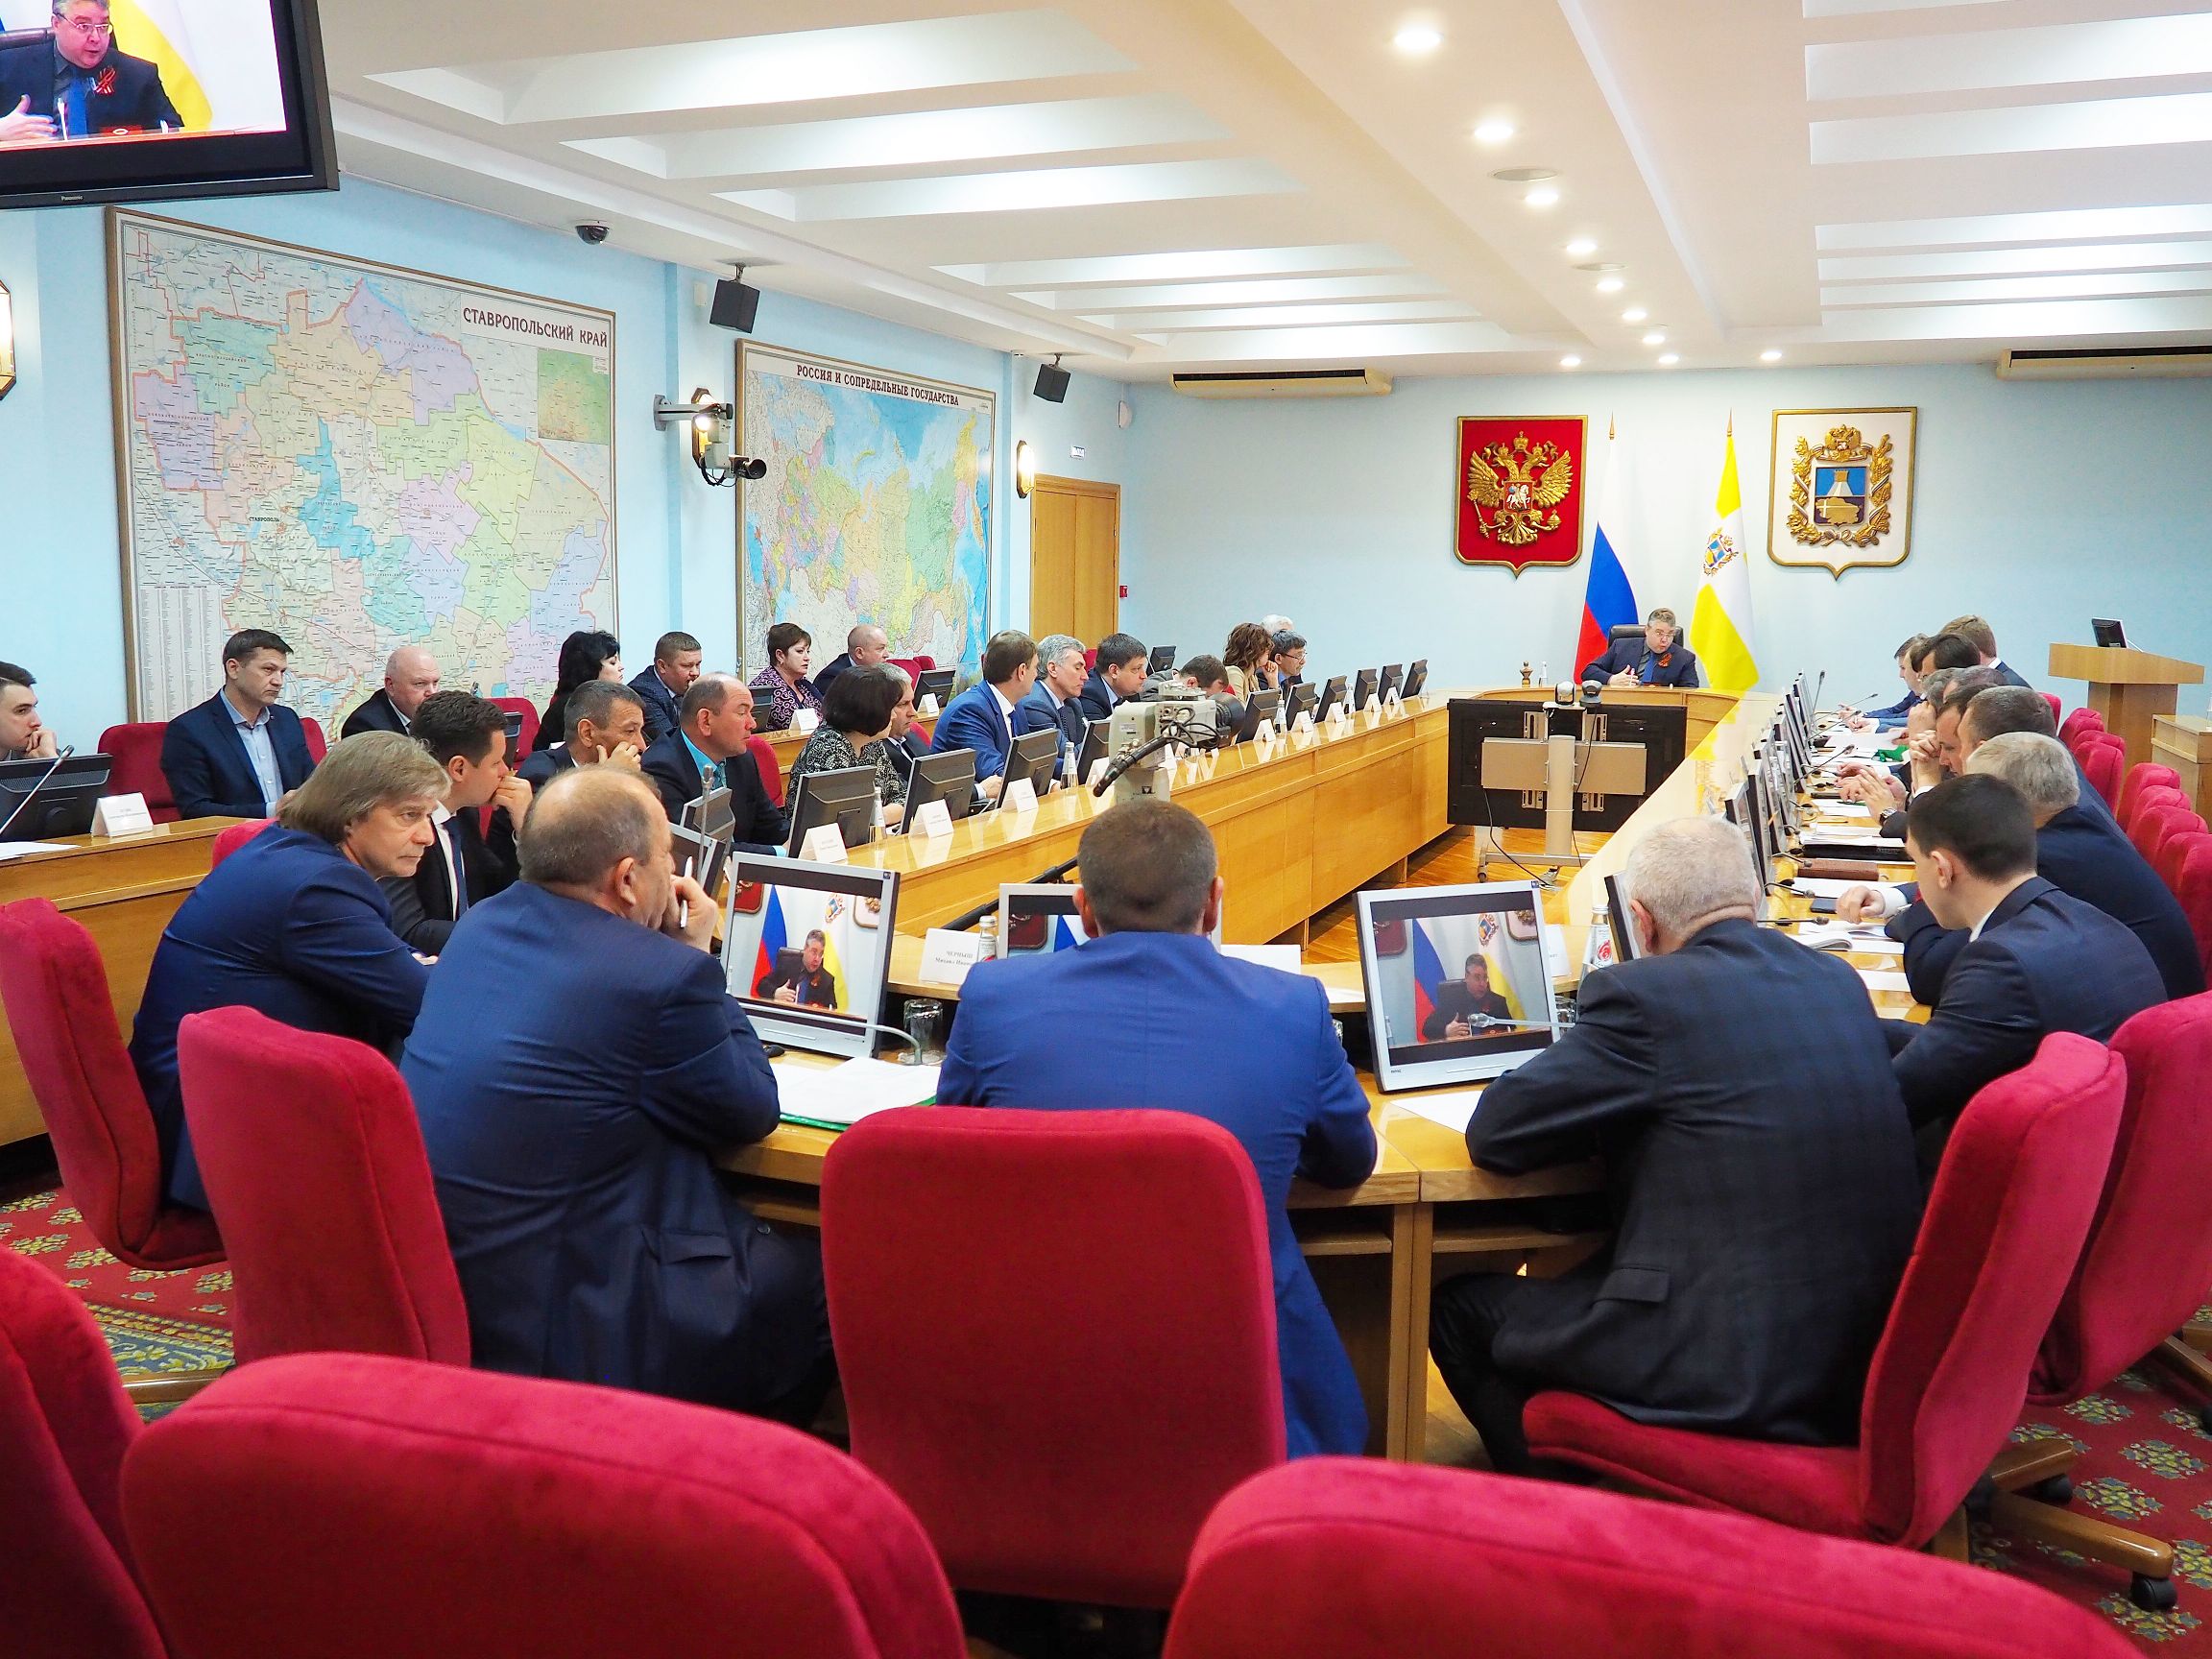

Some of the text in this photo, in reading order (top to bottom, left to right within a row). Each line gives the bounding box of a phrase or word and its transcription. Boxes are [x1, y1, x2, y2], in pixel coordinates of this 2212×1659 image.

[463, 307, 608, 348] СТАВРОПОЛЬСКИЙ КРАЙ
[796, 365, 959, 406] РОССИЯ И СОПРЕДЕЛЬНЫЕ ГОСУДАРСТВА
